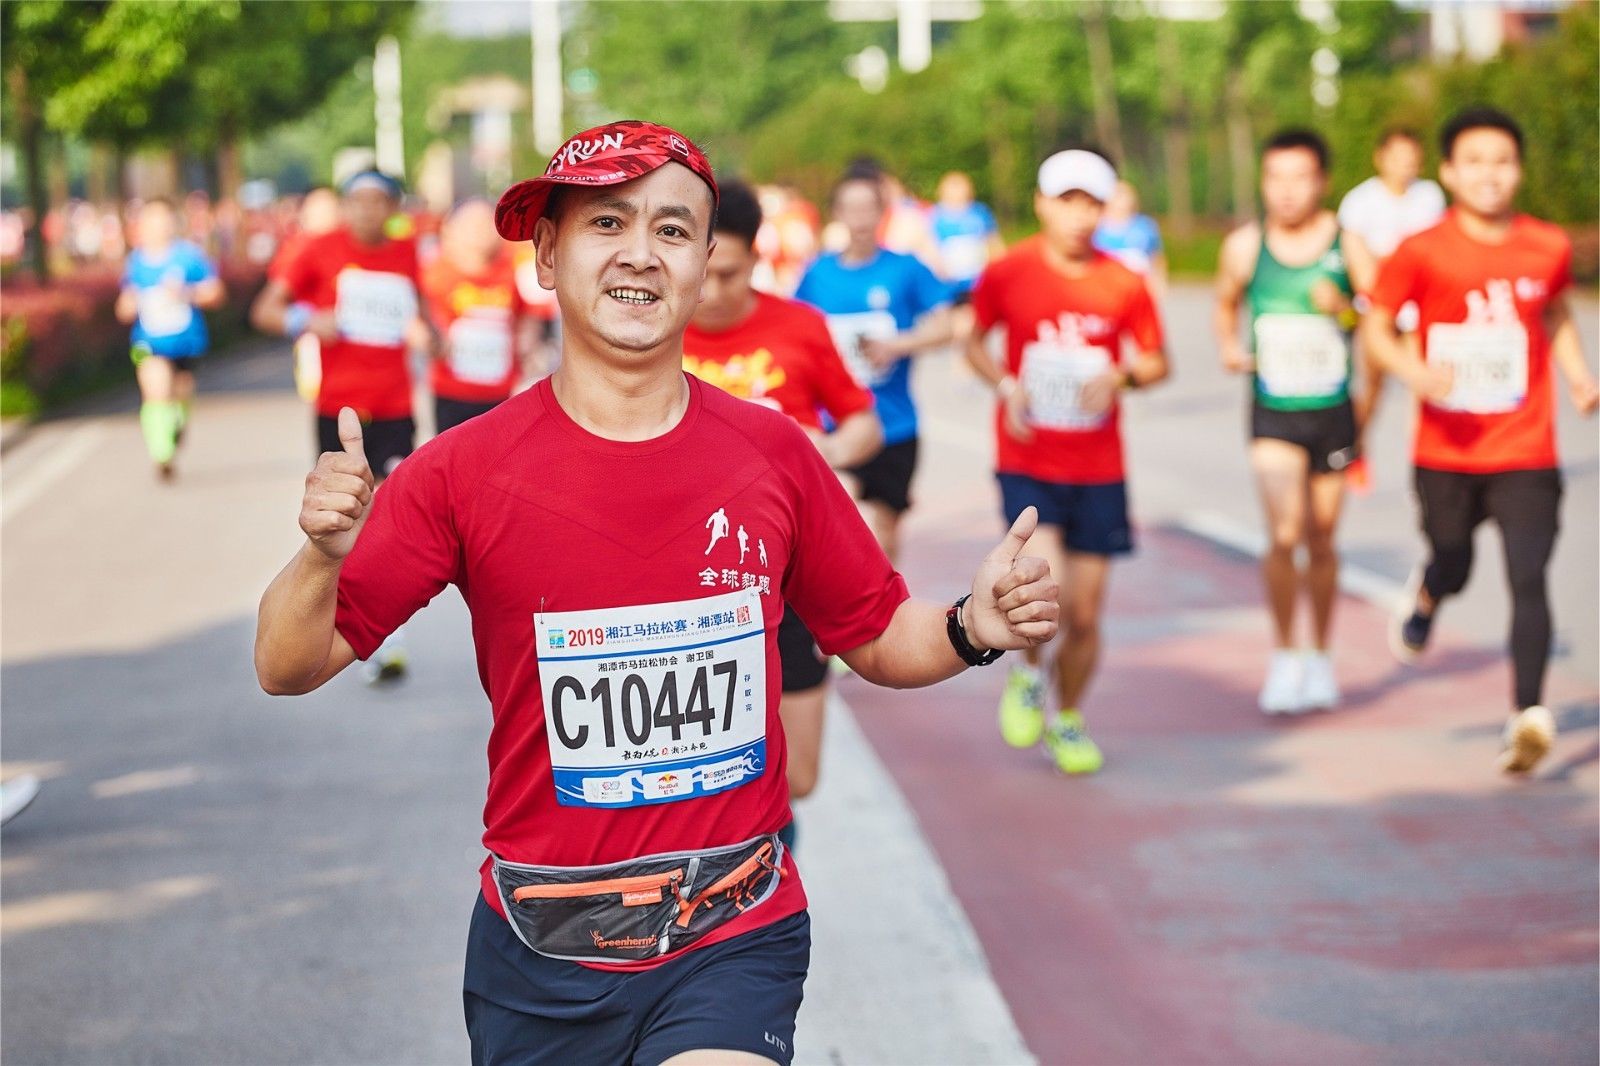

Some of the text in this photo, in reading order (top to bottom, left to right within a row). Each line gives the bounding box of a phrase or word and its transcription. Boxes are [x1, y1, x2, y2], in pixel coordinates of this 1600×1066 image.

[568, 628, 604, 647] 2019
[598, 650, 714, 672] 湘潭市马拉松协会 谢卫国
[552, 660, 737, 750] C10447
